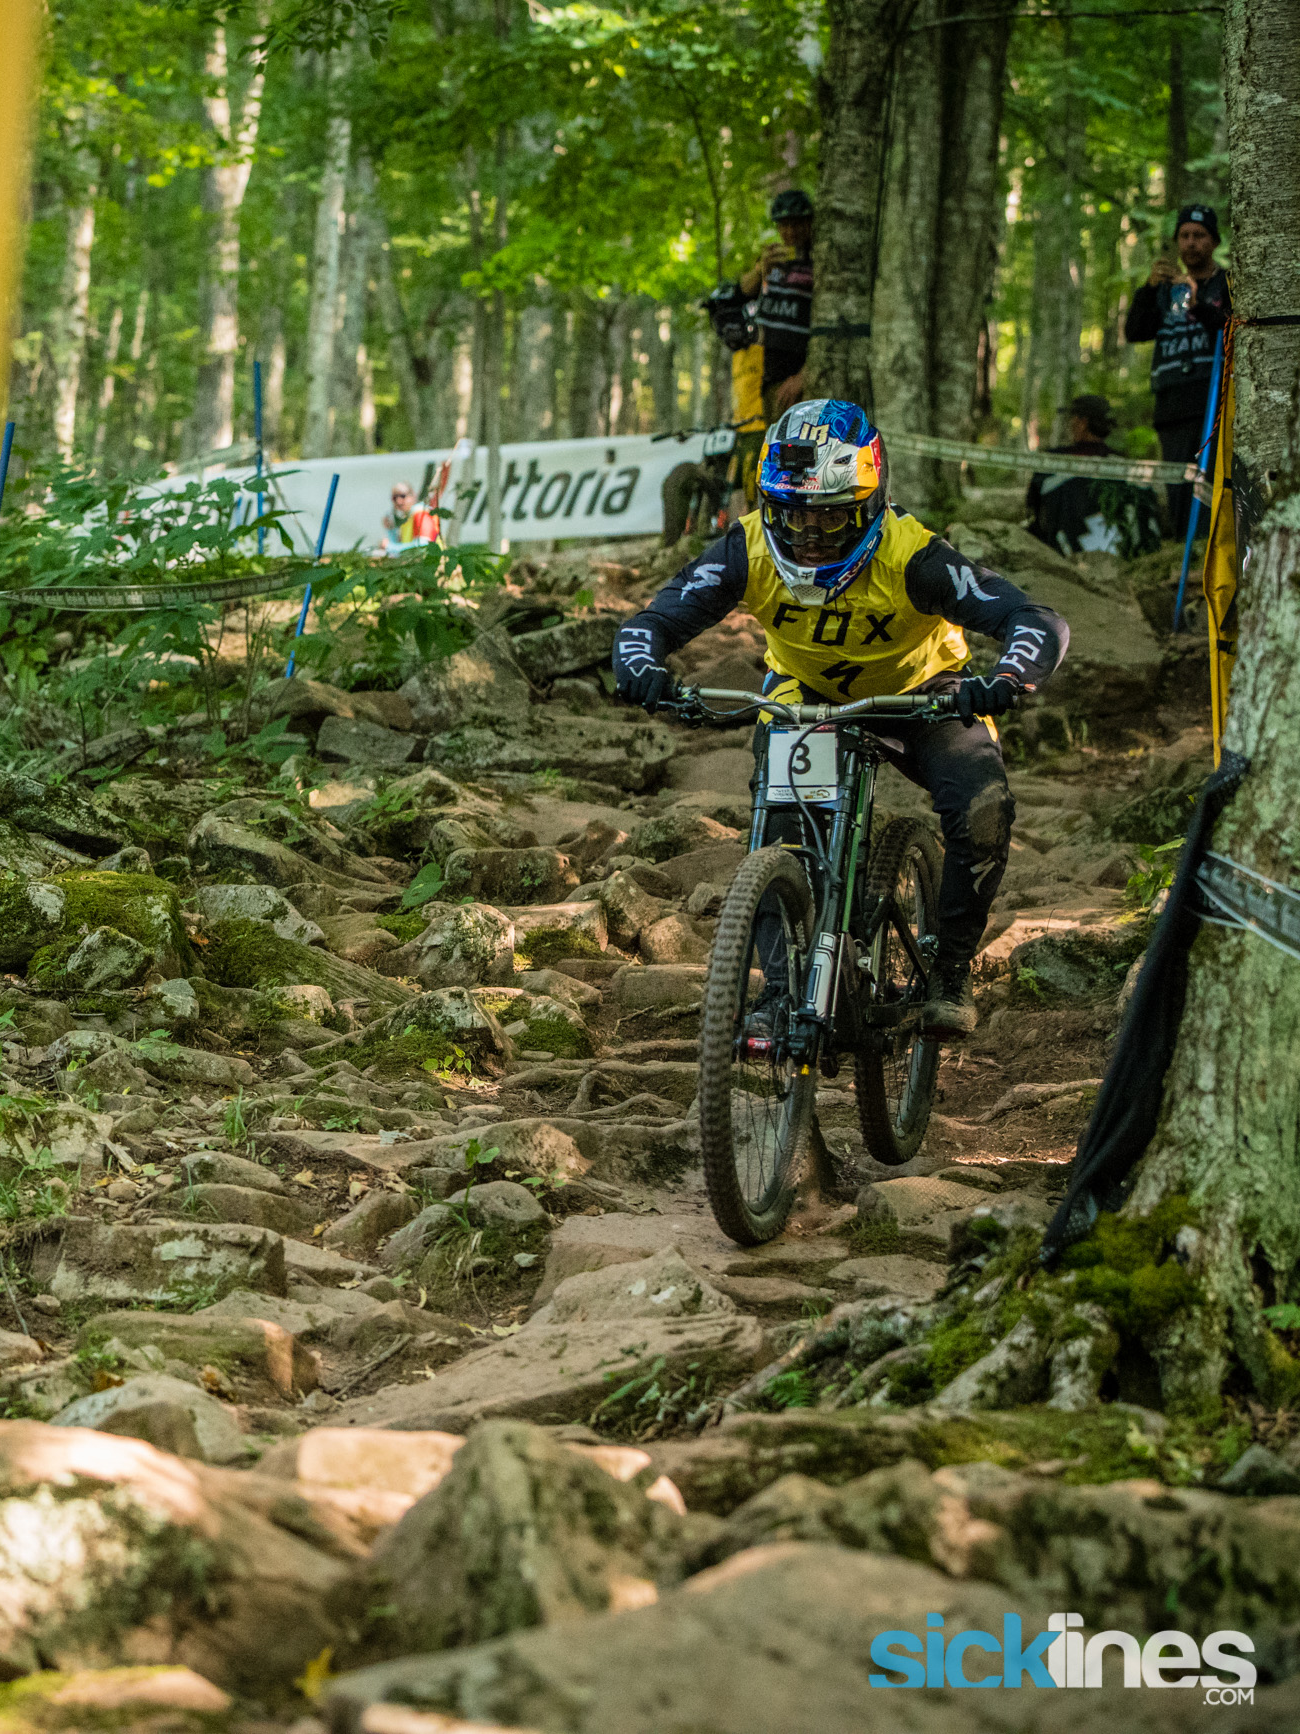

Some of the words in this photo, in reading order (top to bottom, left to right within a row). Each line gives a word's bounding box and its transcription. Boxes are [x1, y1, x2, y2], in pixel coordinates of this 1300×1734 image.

[1159, 331, 1210, 357] TEAM
[772, 602, 897, 647] FOX
[618, 627, 656, 666] FOX
[999, 625, 1047, 674] FOX
[790, 742, 812, 775] 3
